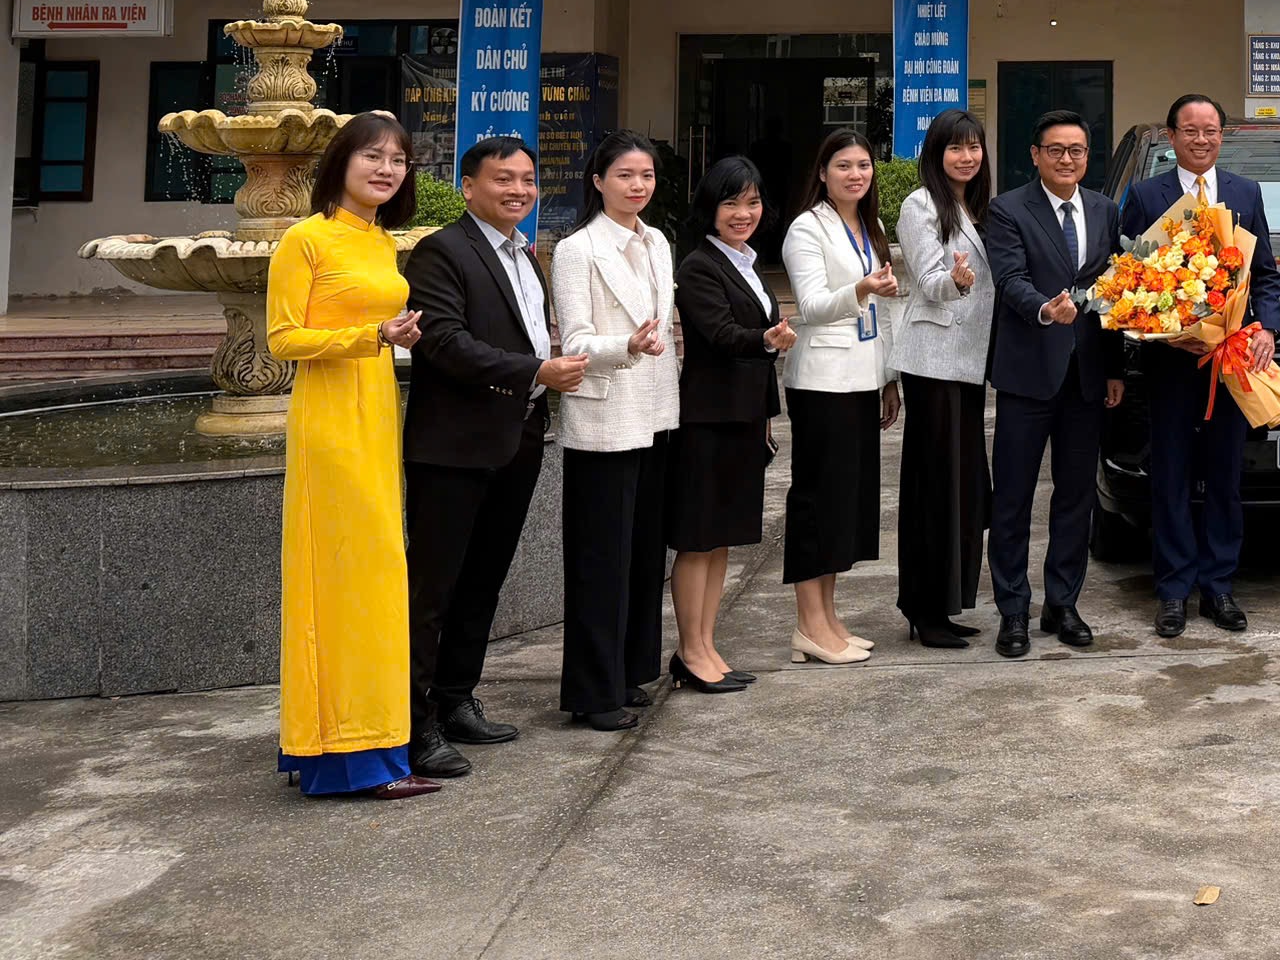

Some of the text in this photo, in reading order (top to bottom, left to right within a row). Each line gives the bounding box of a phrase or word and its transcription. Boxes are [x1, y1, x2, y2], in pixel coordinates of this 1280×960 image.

[32, 3, 146, 24] BỆNH NHÂN RA VIỆN
[475, 2, 532, 29] ĐOÀN KẾT
[917, 3, 946, 21] NHIỆT LIỆT
[914, 30, 948, 46] CHÀO MỪNG
[476, 43, 528, 70] DÂN CHỦ
[914, 59, 925, 77] HỘI
[926, 58, 942, 74] CÔNG
[942, 58, 959, 74] ĐOÀN
[471, 85, 529, 112] KỶ CƯƠNG
[902, 86, 918, 105] BỆNH
[919, 86, 933, 106] VIỆN
[943, 88, 959, 102] KHOA
